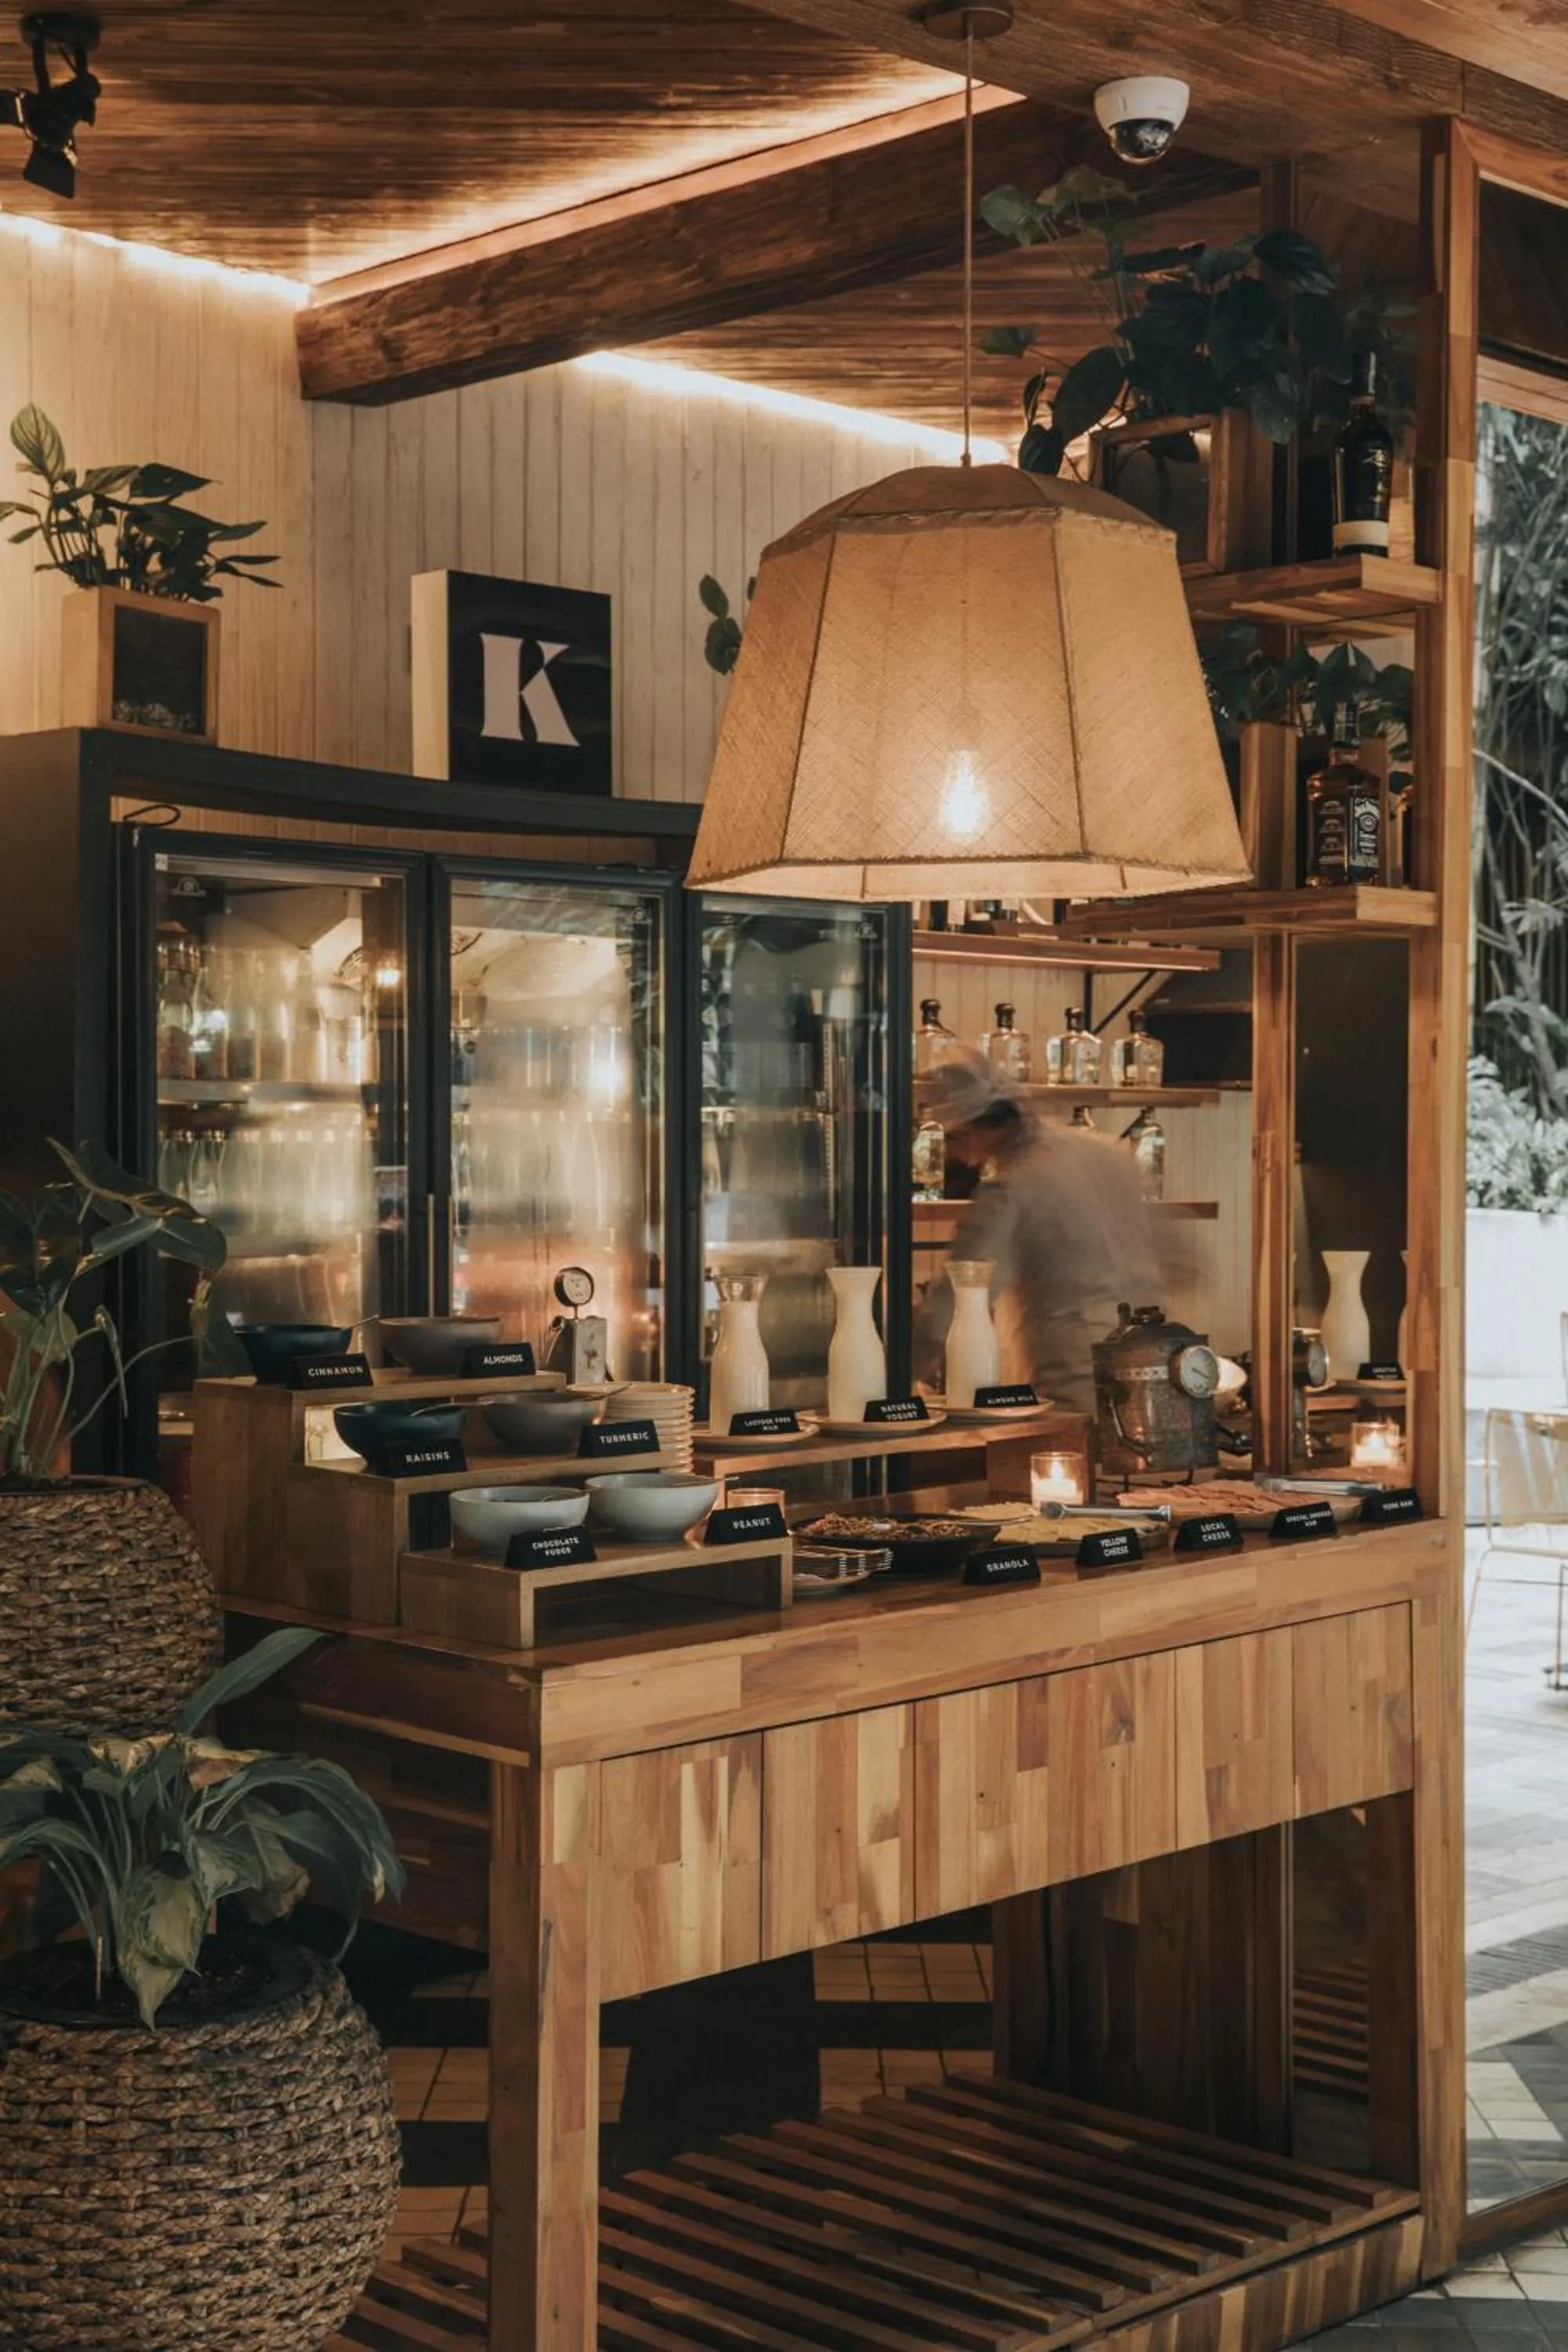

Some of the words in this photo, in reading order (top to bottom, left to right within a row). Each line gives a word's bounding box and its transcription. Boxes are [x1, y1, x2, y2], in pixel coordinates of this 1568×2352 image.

[479, 632, 580, 747] K
[483, 1354, 524, 1365] ALMONDS
[308, 1366, 364, 1377] CINNAMON
[880, 1402, 917, 1414] NATURAL
[885, 1410, 918, 1421] YOGURT
[599, 1431, 650, 1443] TURMERIC
[405, 1450, 450, 1464] RAISINS
[732, 1517, 771, 1530] PEANUT
[1200, 1521, 1226, 1533] LOCAL
[1100, 1536, 1127, 1548] YELLOW
[1202, 1530, 1231, 1542] CHEESE
[532, 1537, 579, 1550] CHOCOLATE
[545, 1547, 572, 1556] FUDGE
[1103, 1545, 1129, 1556] CHEESE
[987, 1558, 1029, 1573] GRANOLA
